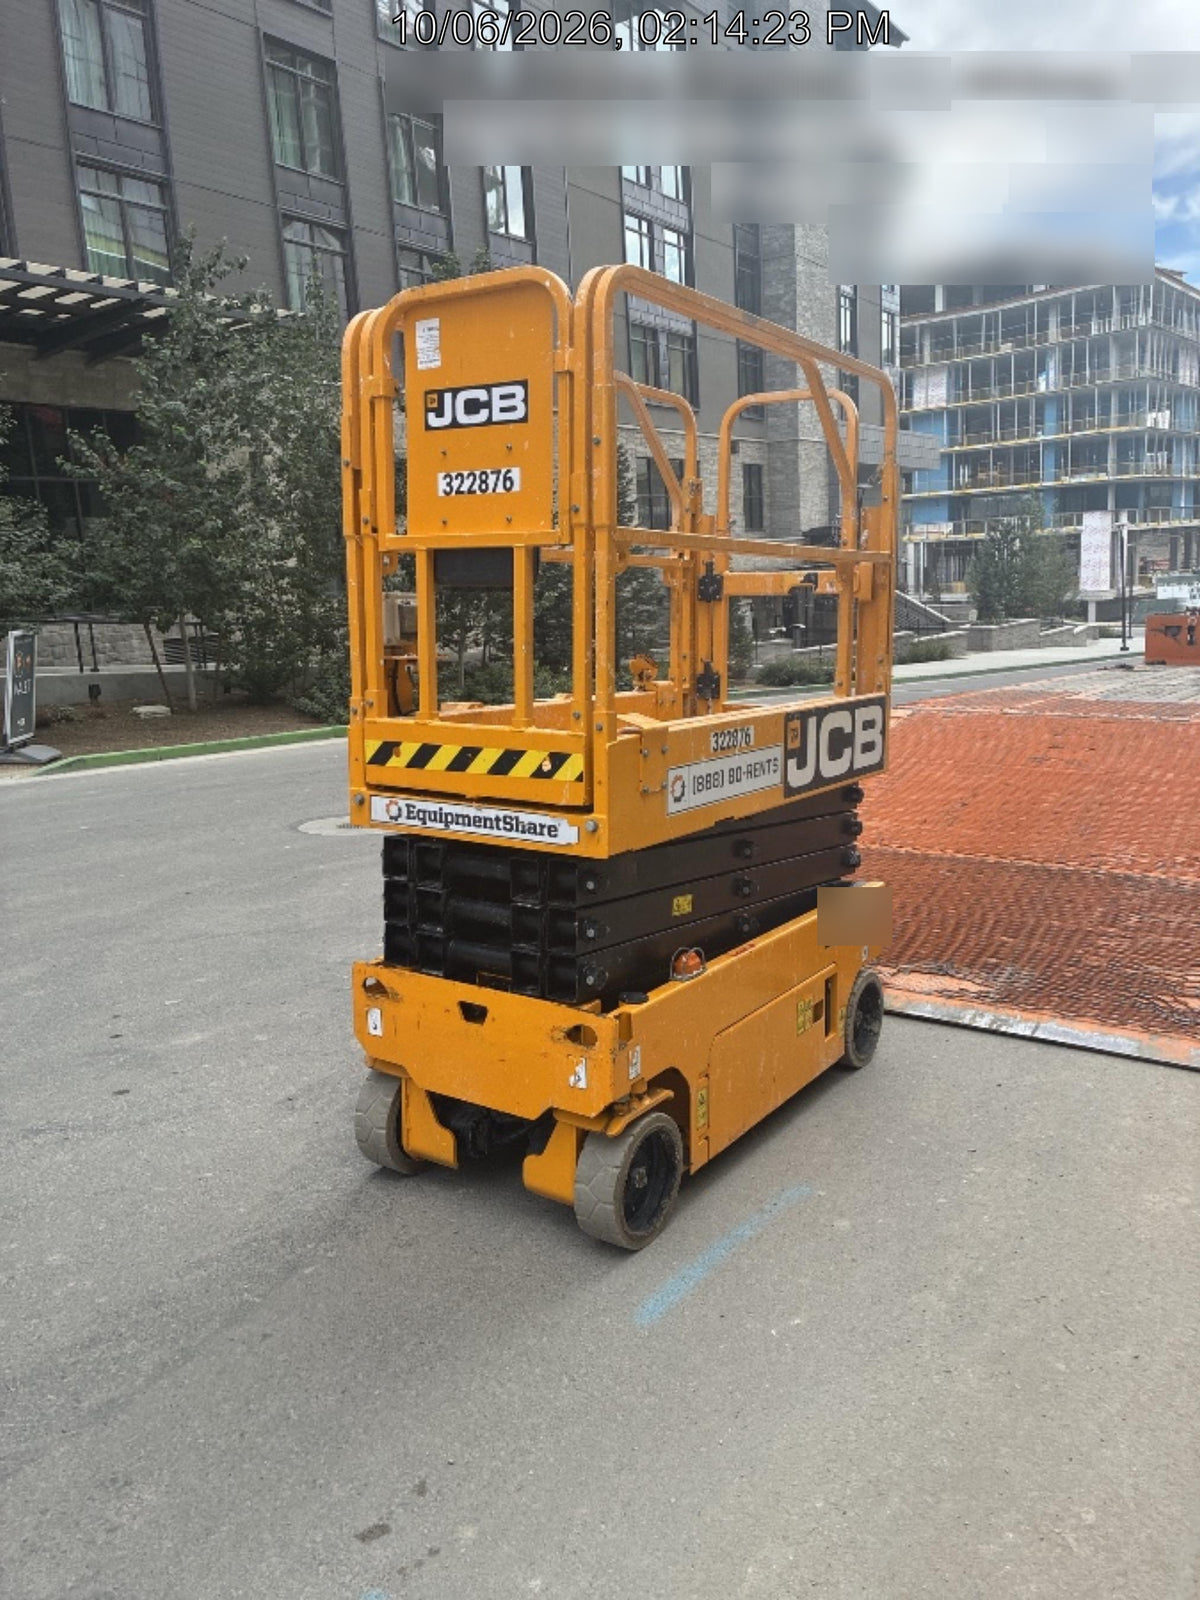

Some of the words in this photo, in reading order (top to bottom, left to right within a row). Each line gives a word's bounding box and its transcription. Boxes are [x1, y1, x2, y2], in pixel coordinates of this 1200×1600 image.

[427, 385, 527, 428] JCB
[442, 468, 514, 496] 322876
[712, 728, 751, 752] 322876
[786, 705, 884, 789] JCB
[692, 769, 725, 795] (888)
[404, 803, 560, 839] EquipmentShare
